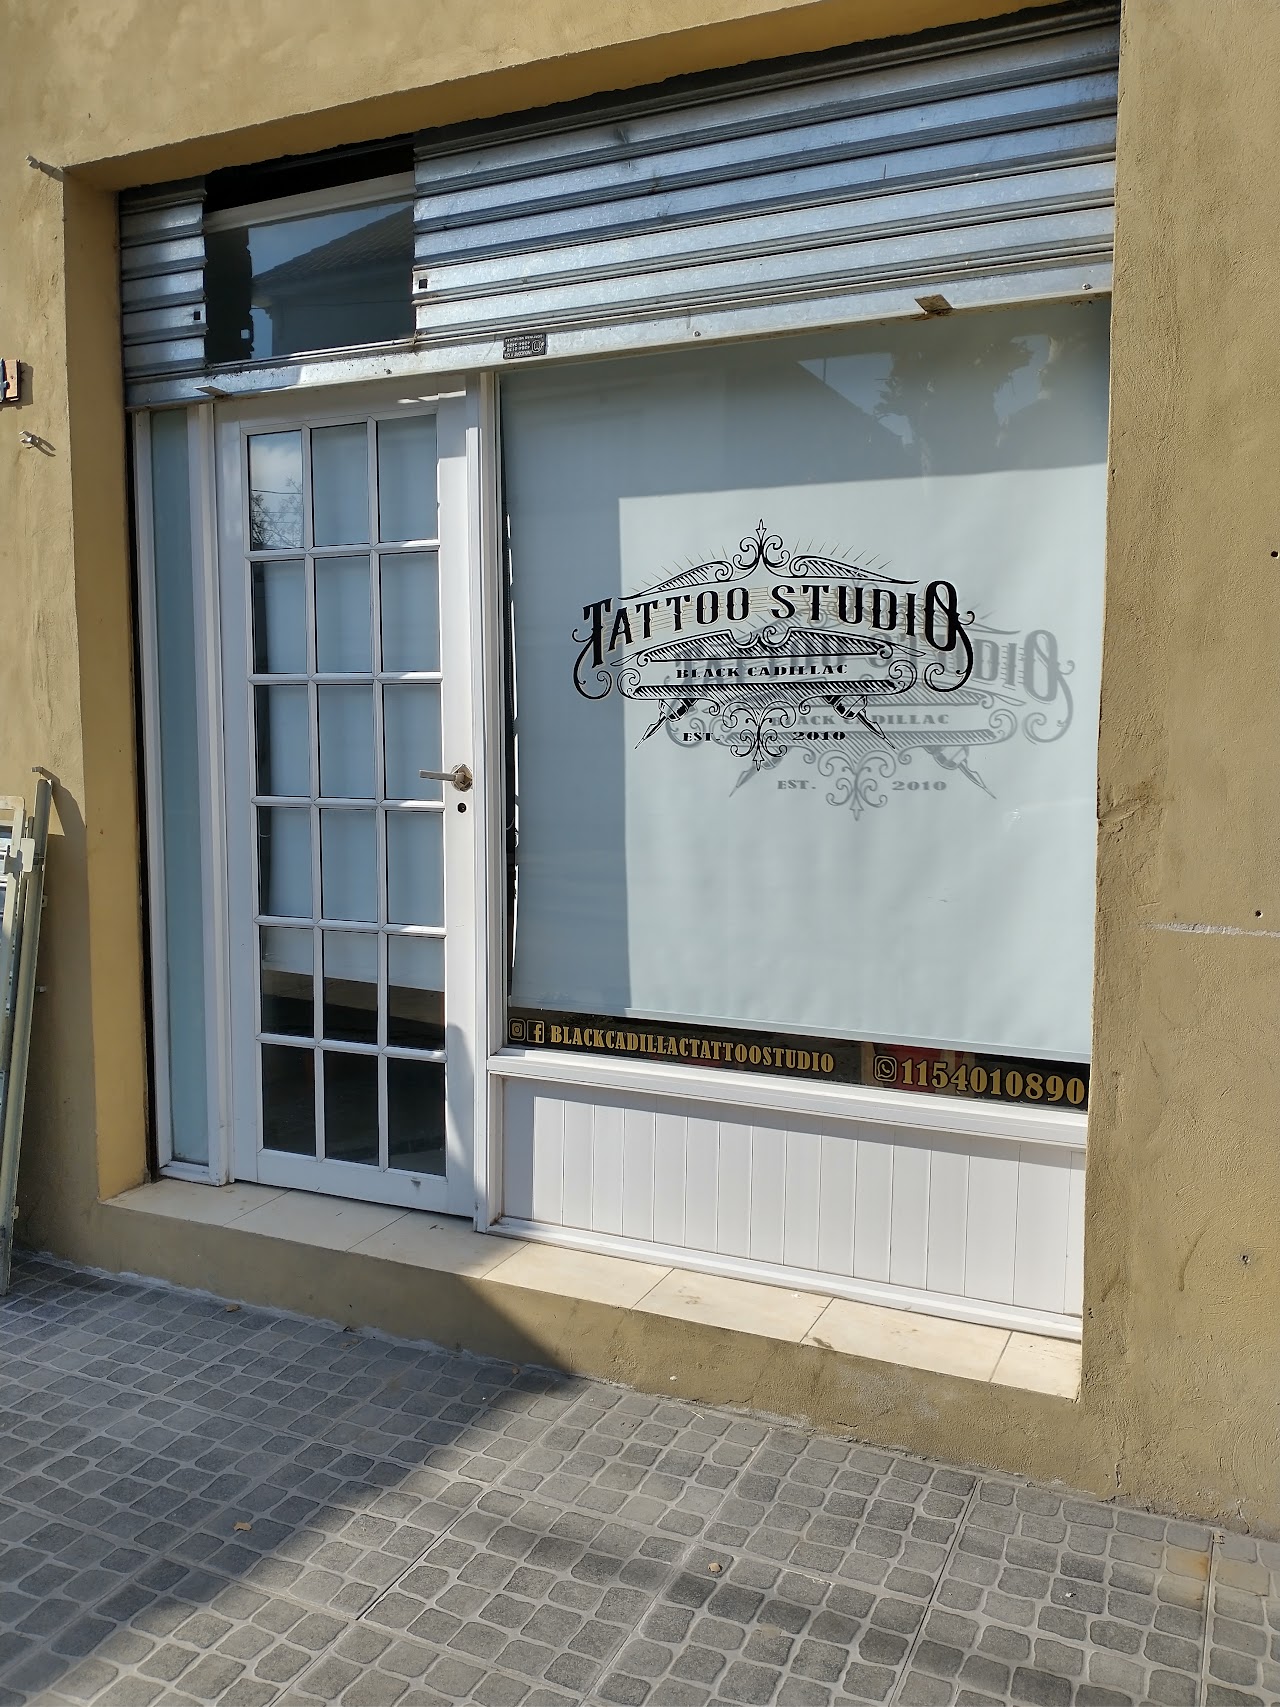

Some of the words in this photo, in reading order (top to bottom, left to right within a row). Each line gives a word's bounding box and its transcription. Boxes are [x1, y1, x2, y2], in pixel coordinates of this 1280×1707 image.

[573, 586, 751, 688] TATTOO
[770, 581, 974, 680] STUDIO
[676, 667, 740, 679] BLACK
[747, 664, 848, 677] CADILLAC
[682, 731, 721, 742] EST.
[792, 731, 847, 741] 2010
[777, 779, 817, 790] EST.
[891, 780, 947, 791] 2010
[550, 1024, 835, 1073] BLACKCADILLACTATTOOSTUDIO
[901, 1058, 1085, 1105] 1154010890
